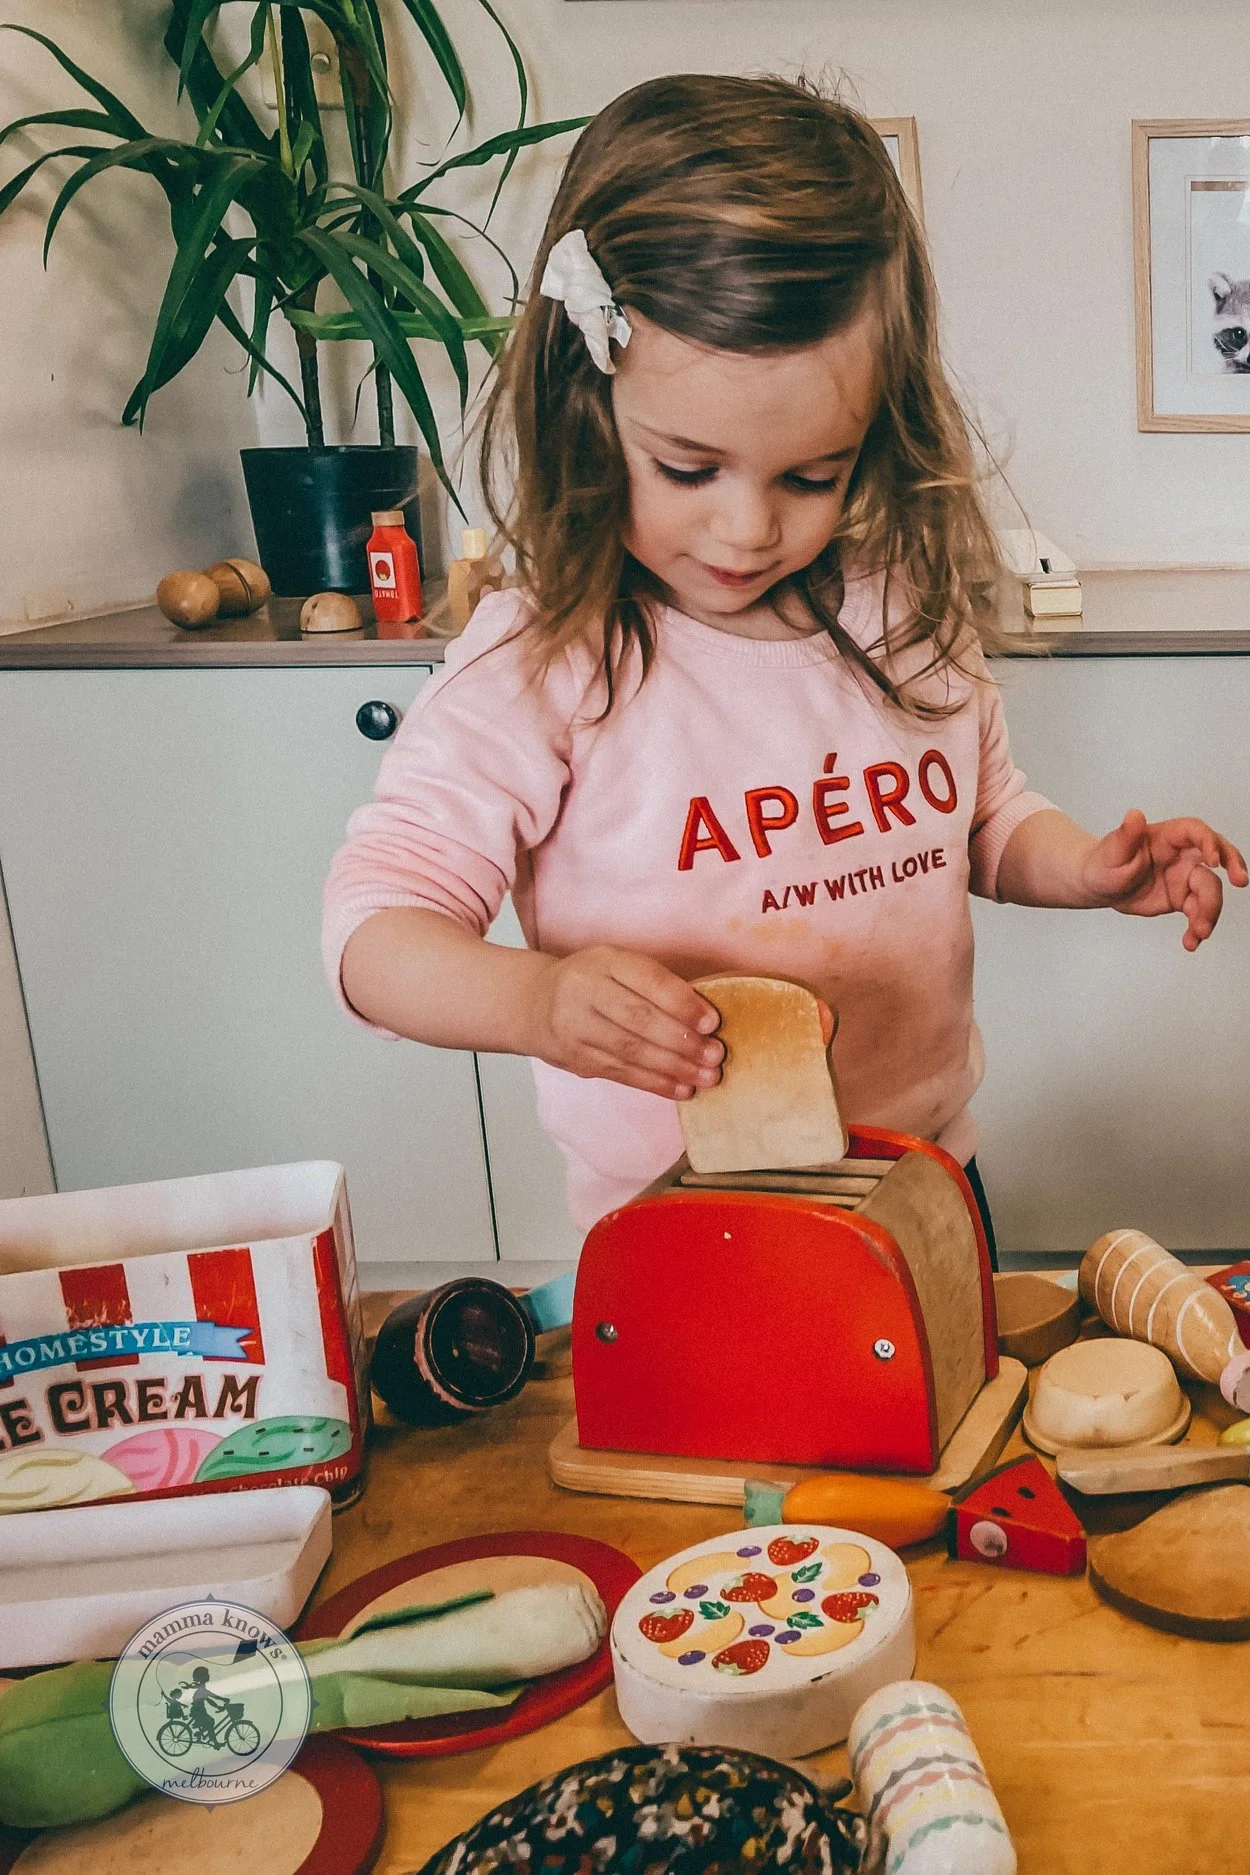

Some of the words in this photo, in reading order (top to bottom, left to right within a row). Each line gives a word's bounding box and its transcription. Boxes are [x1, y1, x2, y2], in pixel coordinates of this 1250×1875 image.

[678, 749, 958, 871] APÉRO
[761, 882, 819, 913] A/W
[823, 865, 886, 901] WITH
[890, 848, 947, 883] LOVE
[47, 1374, 261, 1434] CREAM
